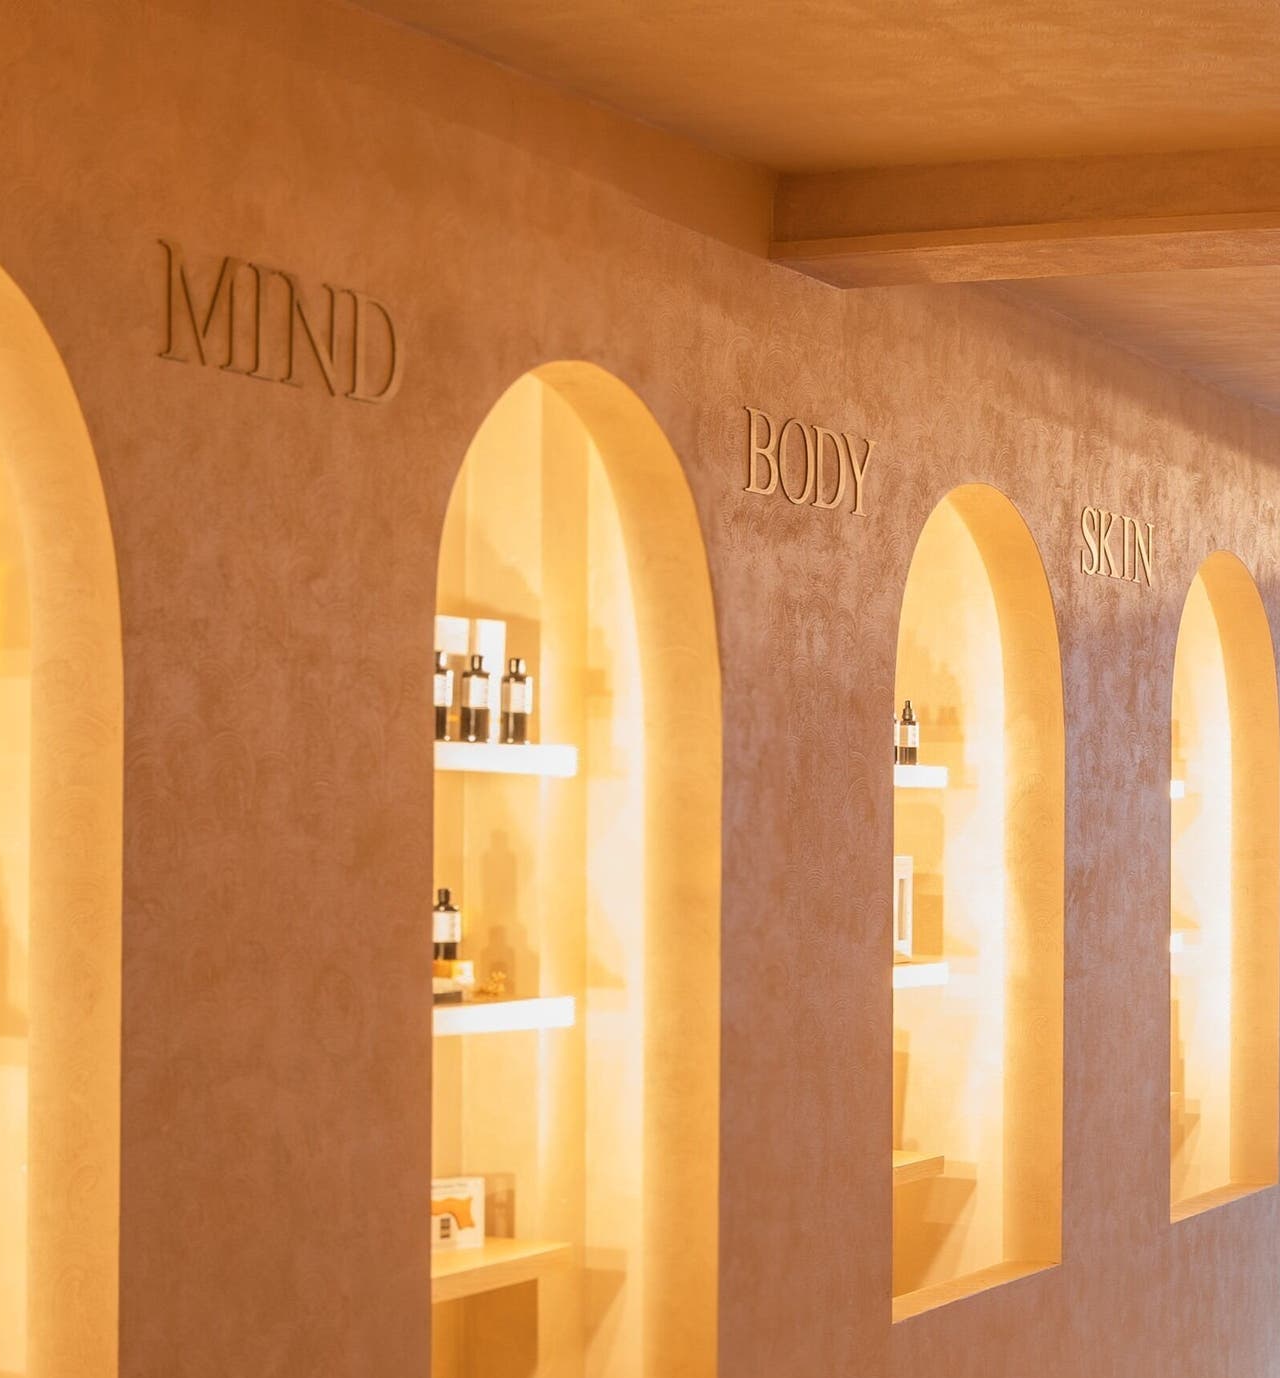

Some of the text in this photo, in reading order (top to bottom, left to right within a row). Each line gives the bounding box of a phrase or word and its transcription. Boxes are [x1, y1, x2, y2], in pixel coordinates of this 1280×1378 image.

[156, 238, 404, 404] MIND
[744, 406, 877, 517] BODY
[1080, 506, 1155, 587] SKIN
